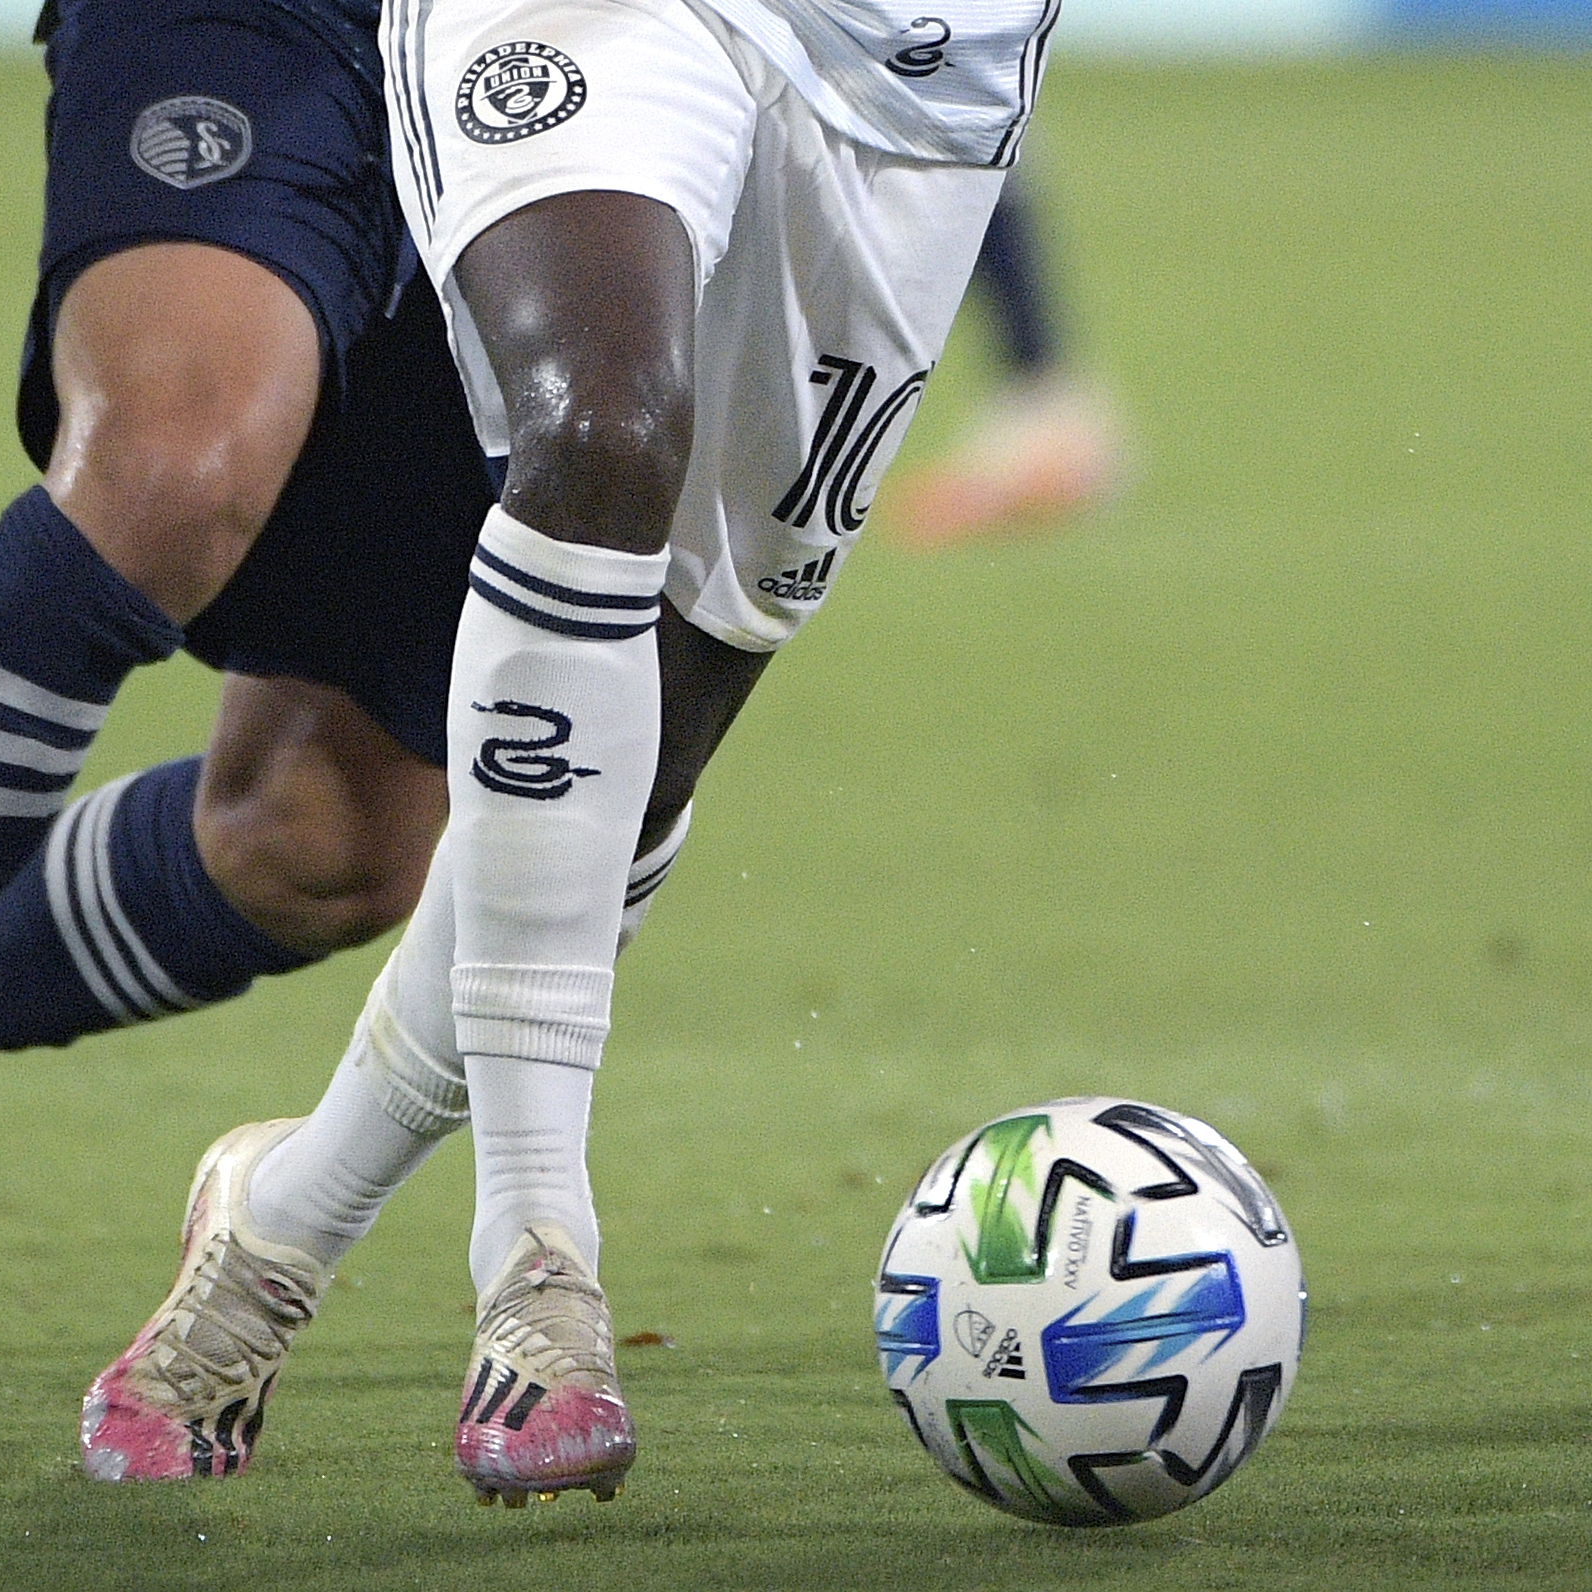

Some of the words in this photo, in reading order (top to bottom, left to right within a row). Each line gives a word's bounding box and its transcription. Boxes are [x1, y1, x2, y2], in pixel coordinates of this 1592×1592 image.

[458, 42, 583, 109] PHILADELPHIA
[489, 66, 543, 88] UNION
[771, 354, 935, 537] 10
[757, 576, 827, 601] adidas
[982, 1328, 1019, 1379] adidas
